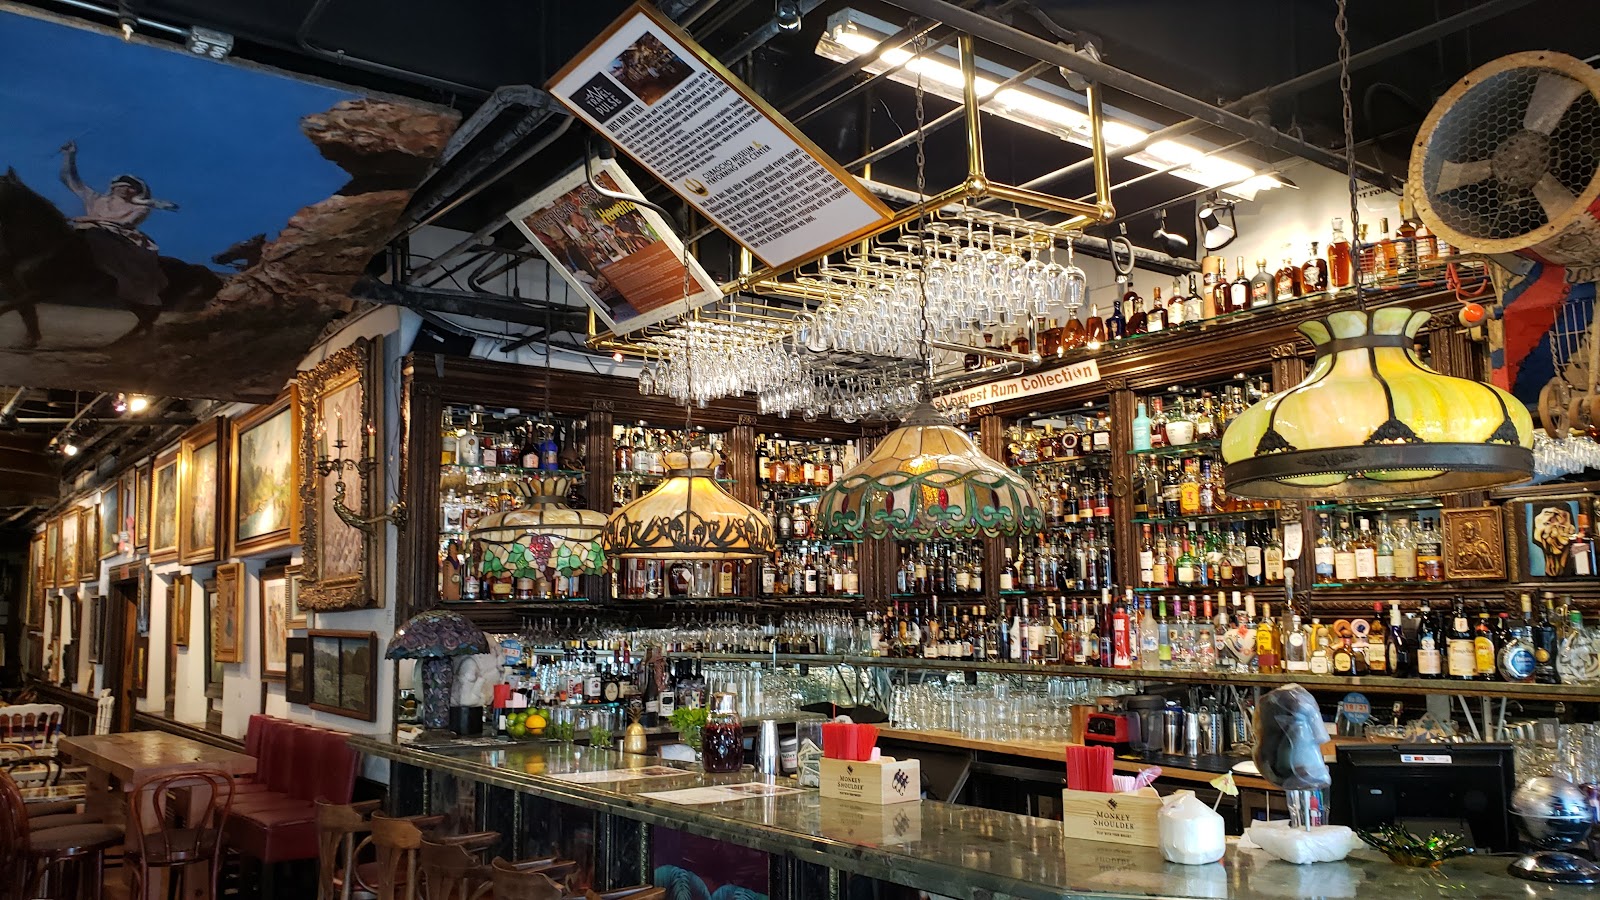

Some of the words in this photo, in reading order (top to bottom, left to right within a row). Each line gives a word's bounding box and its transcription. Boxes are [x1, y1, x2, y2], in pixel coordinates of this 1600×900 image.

[586, 87, 611, 107] TRAVEL
[595, 94, 622, 116] PULSE
[616, 114, 631, 125] BAR
[701, 159, 733, 179] CUBAOCHO
[730, 145, 756, 162] MUSEUM
[751, 140, 762, 148] &
[705, 164, 739, 185] PERFORMING
[736, 156, 752, 168] ARTS
[748, 144, 772, 160] CENTER
[533, 201, 577, 230] AMERICAN
[596, 200, 637, 225] Havana
[990, 383, 1019, 398] Rum
[1020, 365, 1093, 391] Collection
[837, 782, 864, 790] SHOULDER
[839, 775, 861, 784] MONKEY
[1092, 819, 1135, 830] SHOULDER
[1096, 810, 1130, 821] MONKEY
